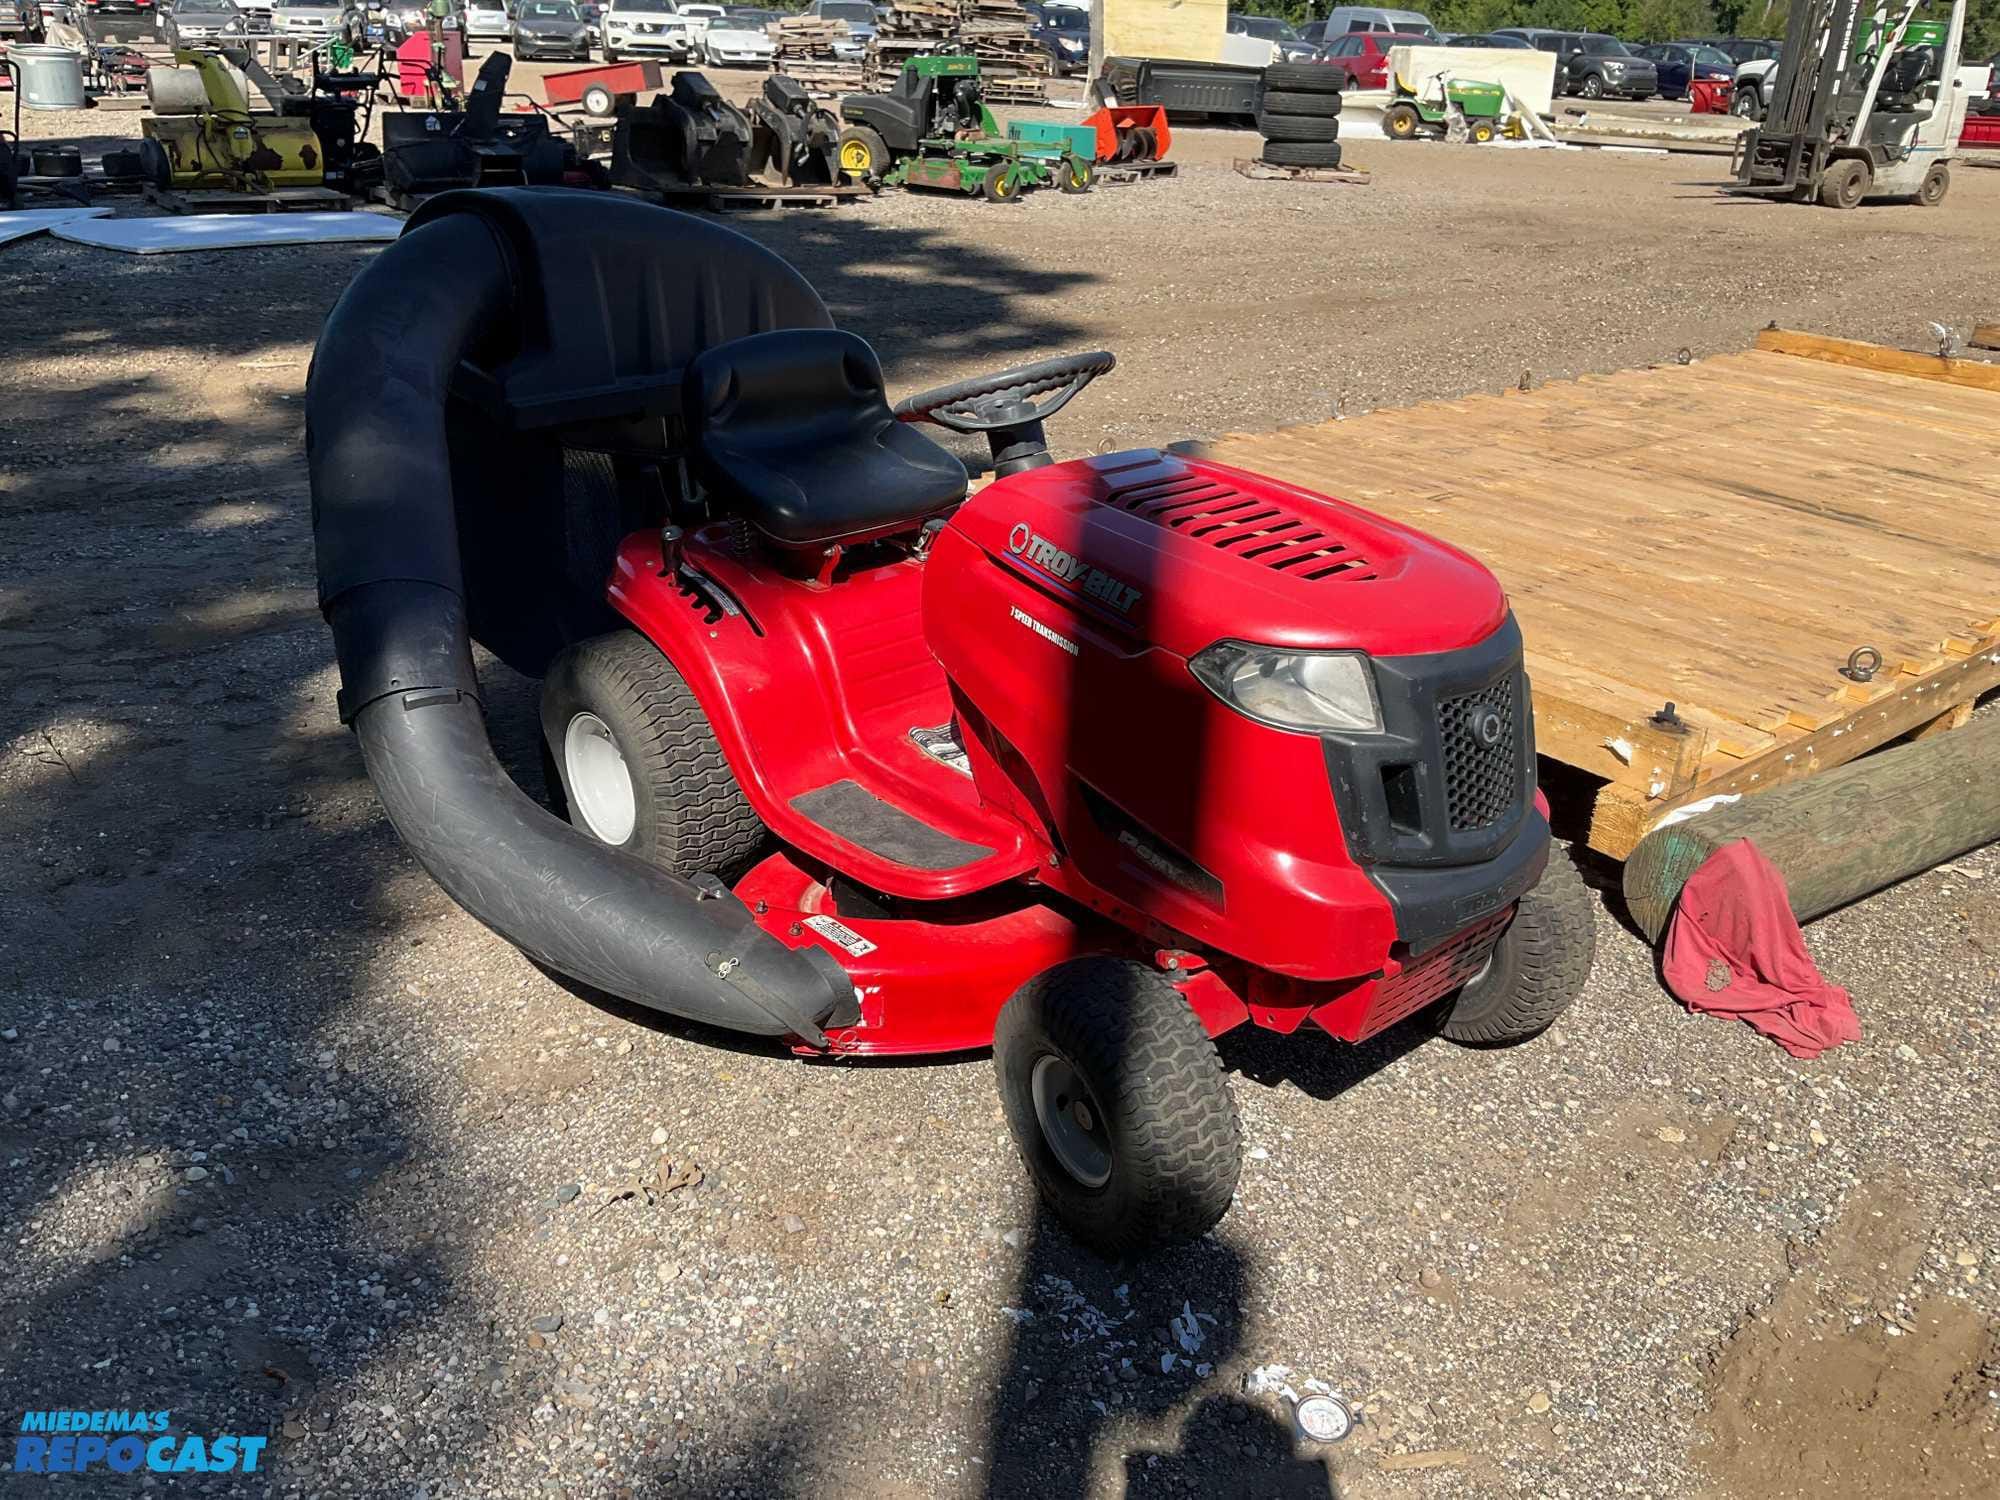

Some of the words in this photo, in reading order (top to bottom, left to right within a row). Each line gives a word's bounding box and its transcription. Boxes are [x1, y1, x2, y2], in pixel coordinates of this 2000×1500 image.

[1842, 4, 1858, 50] NISSAN
[1026, 534, 1143, 613] TROY-BILT
[1014, 608, 1033, 629] SPEED
[1032, 619, 1079, 657] TRANSMISSION
